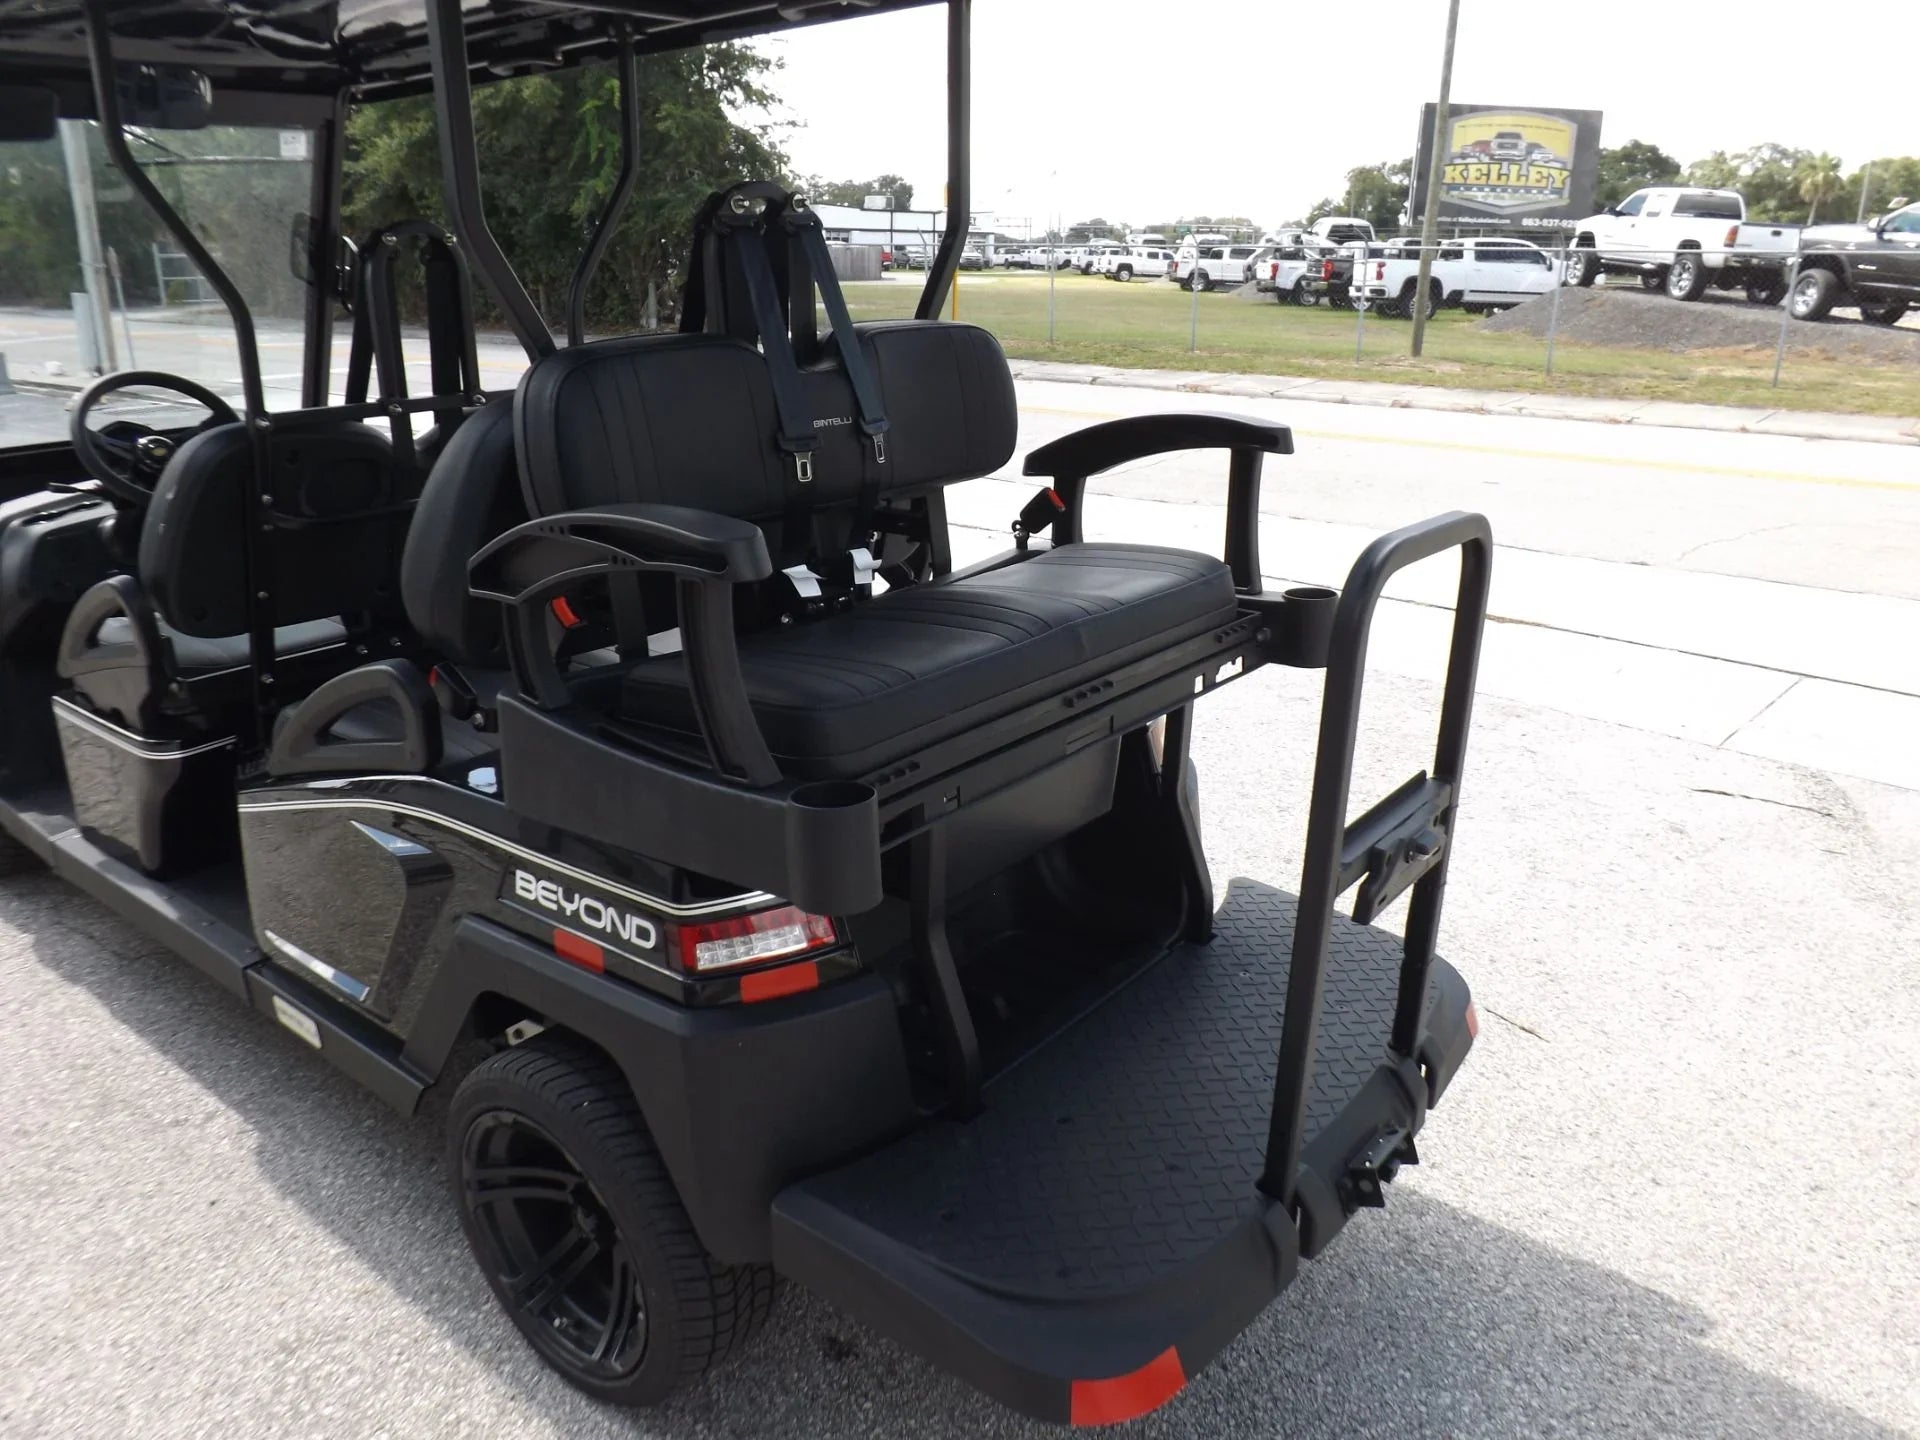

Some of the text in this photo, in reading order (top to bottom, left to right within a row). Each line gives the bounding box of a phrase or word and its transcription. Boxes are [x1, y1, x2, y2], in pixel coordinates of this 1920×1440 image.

[1442, 163, 1570, 188] KELLEY
[813, 416, 852, 428] BINTELLI
[515, 869, 656, 949] BEYOND
